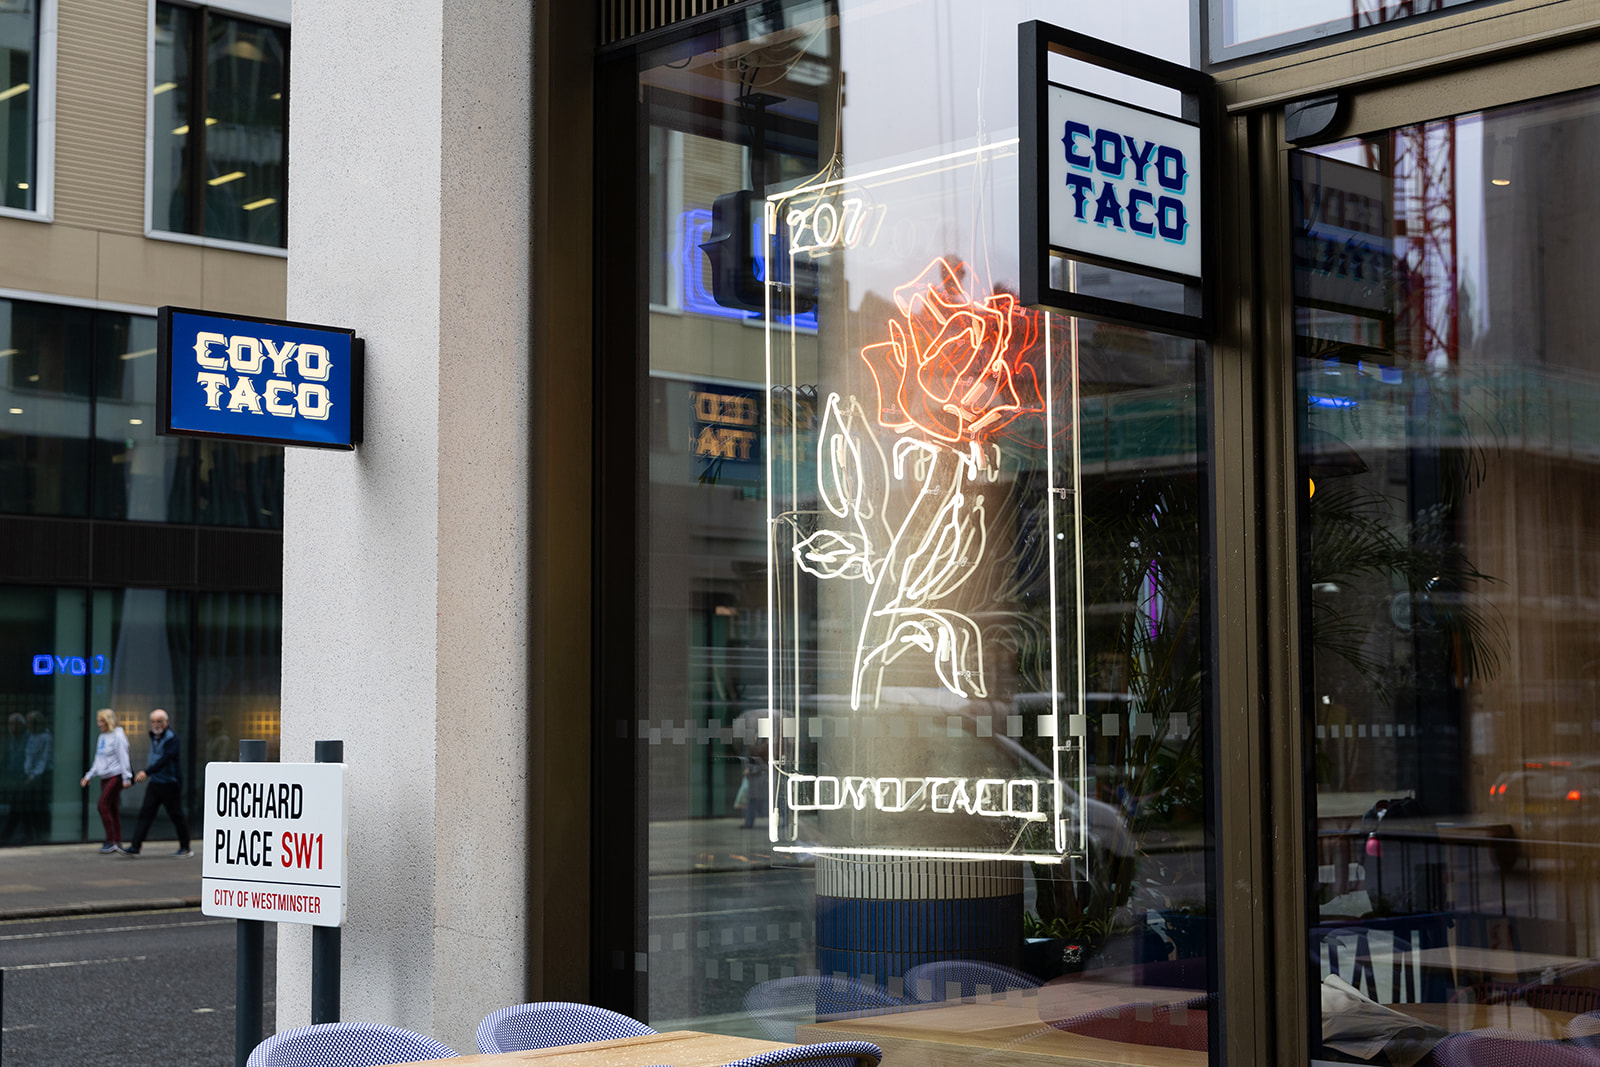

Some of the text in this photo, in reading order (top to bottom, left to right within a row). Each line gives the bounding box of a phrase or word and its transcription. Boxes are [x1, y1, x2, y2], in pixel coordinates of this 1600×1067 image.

[1061, 120, 1189, 195] COYO
[1065, 172, 1189, 245] TACO
[192, 331, 334, 382] COYO
[196, 372, 334, 421] TACO
[216, 782, 303, 819] ORCHARD
[215, 829, 323, 870] PLACE SW1
[214, 888, 321, 914] CITY OF WESTMINSTER
